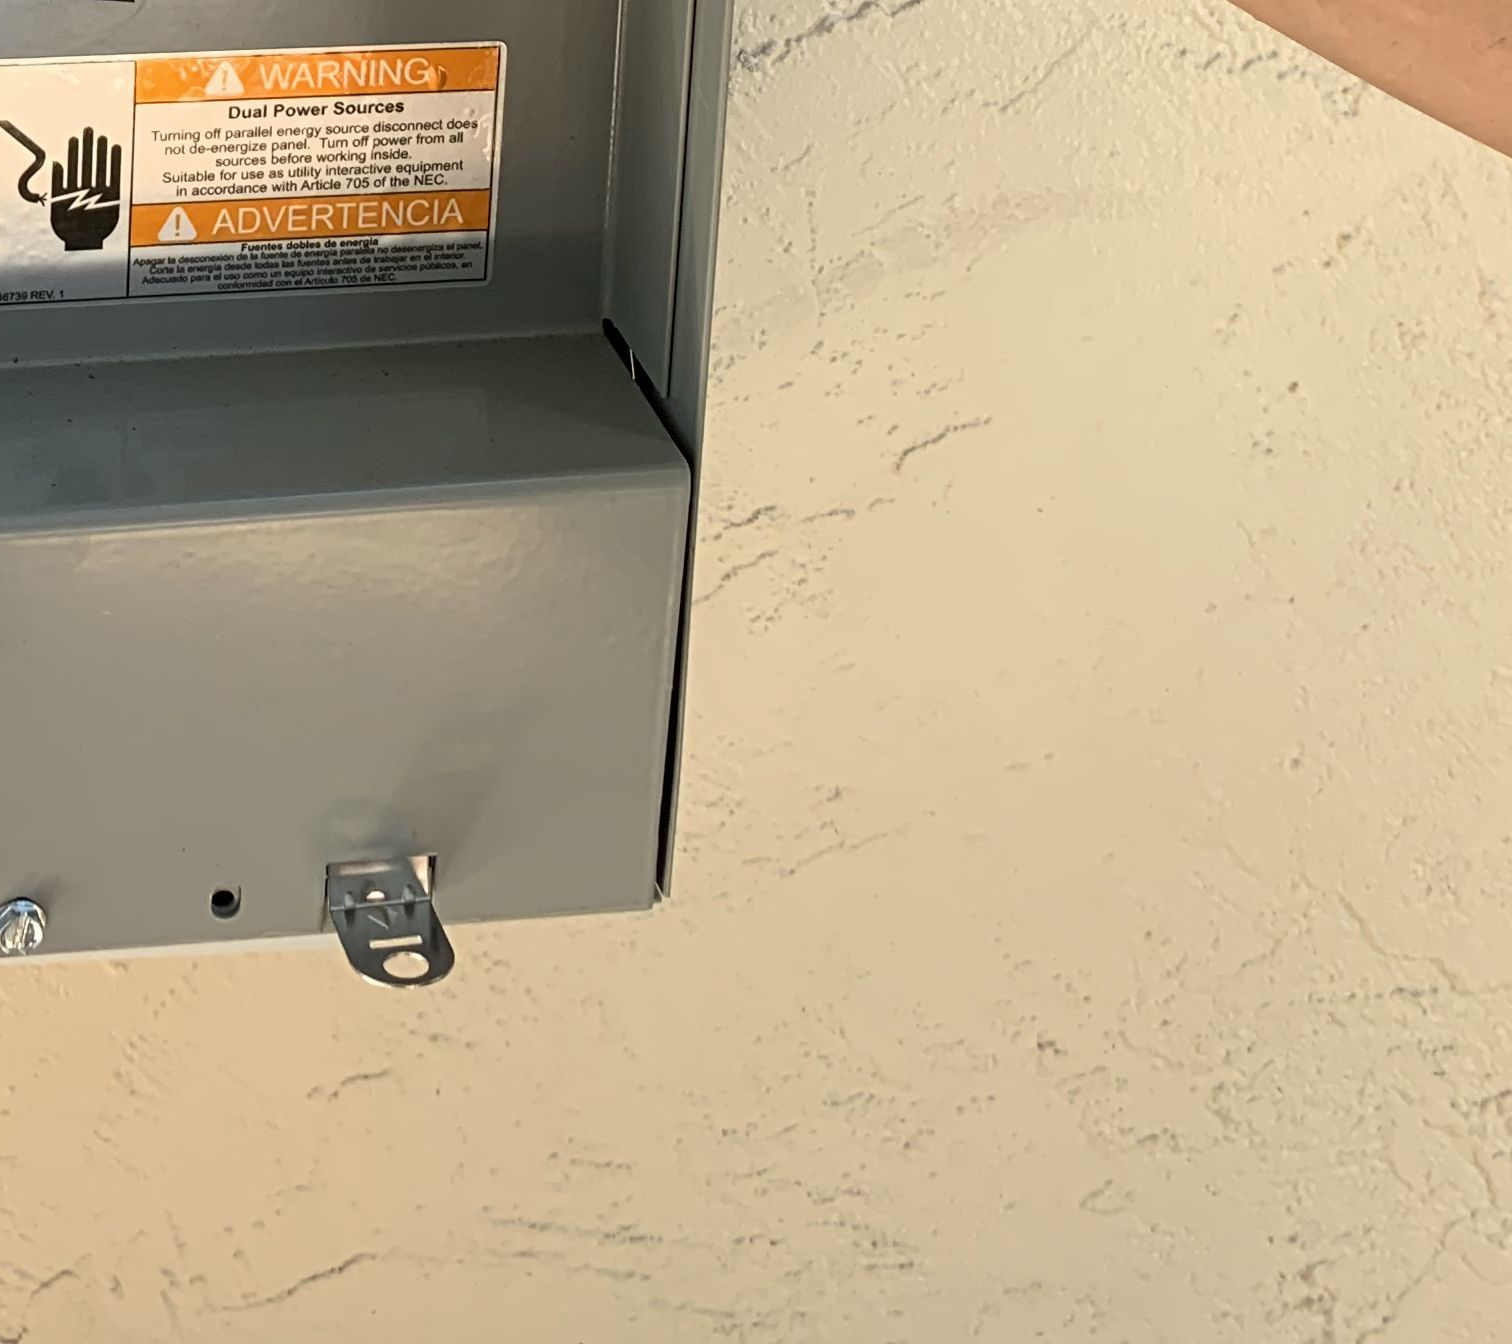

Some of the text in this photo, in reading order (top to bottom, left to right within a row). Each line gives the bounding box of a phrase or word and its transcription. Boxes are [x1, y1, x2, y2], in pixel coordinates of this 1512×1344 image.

[259, 58, 430, 90] WARNING
[229, 100, 404, 120] Dual Power Sources
[152, 119, 477, 142] Turning parallel energy source disconnect does
[190, 134, 444, 154] de-energize panel. Turn power from
[216, 150, 412, 166] sources before working inside.
[163, 160, 463, 183] Suitable use utility interactive equipment
[192, 174, 447, 196] accordance with Article 705 the NEC.
[212, 198, 463, 235] ADVERTENCIA
